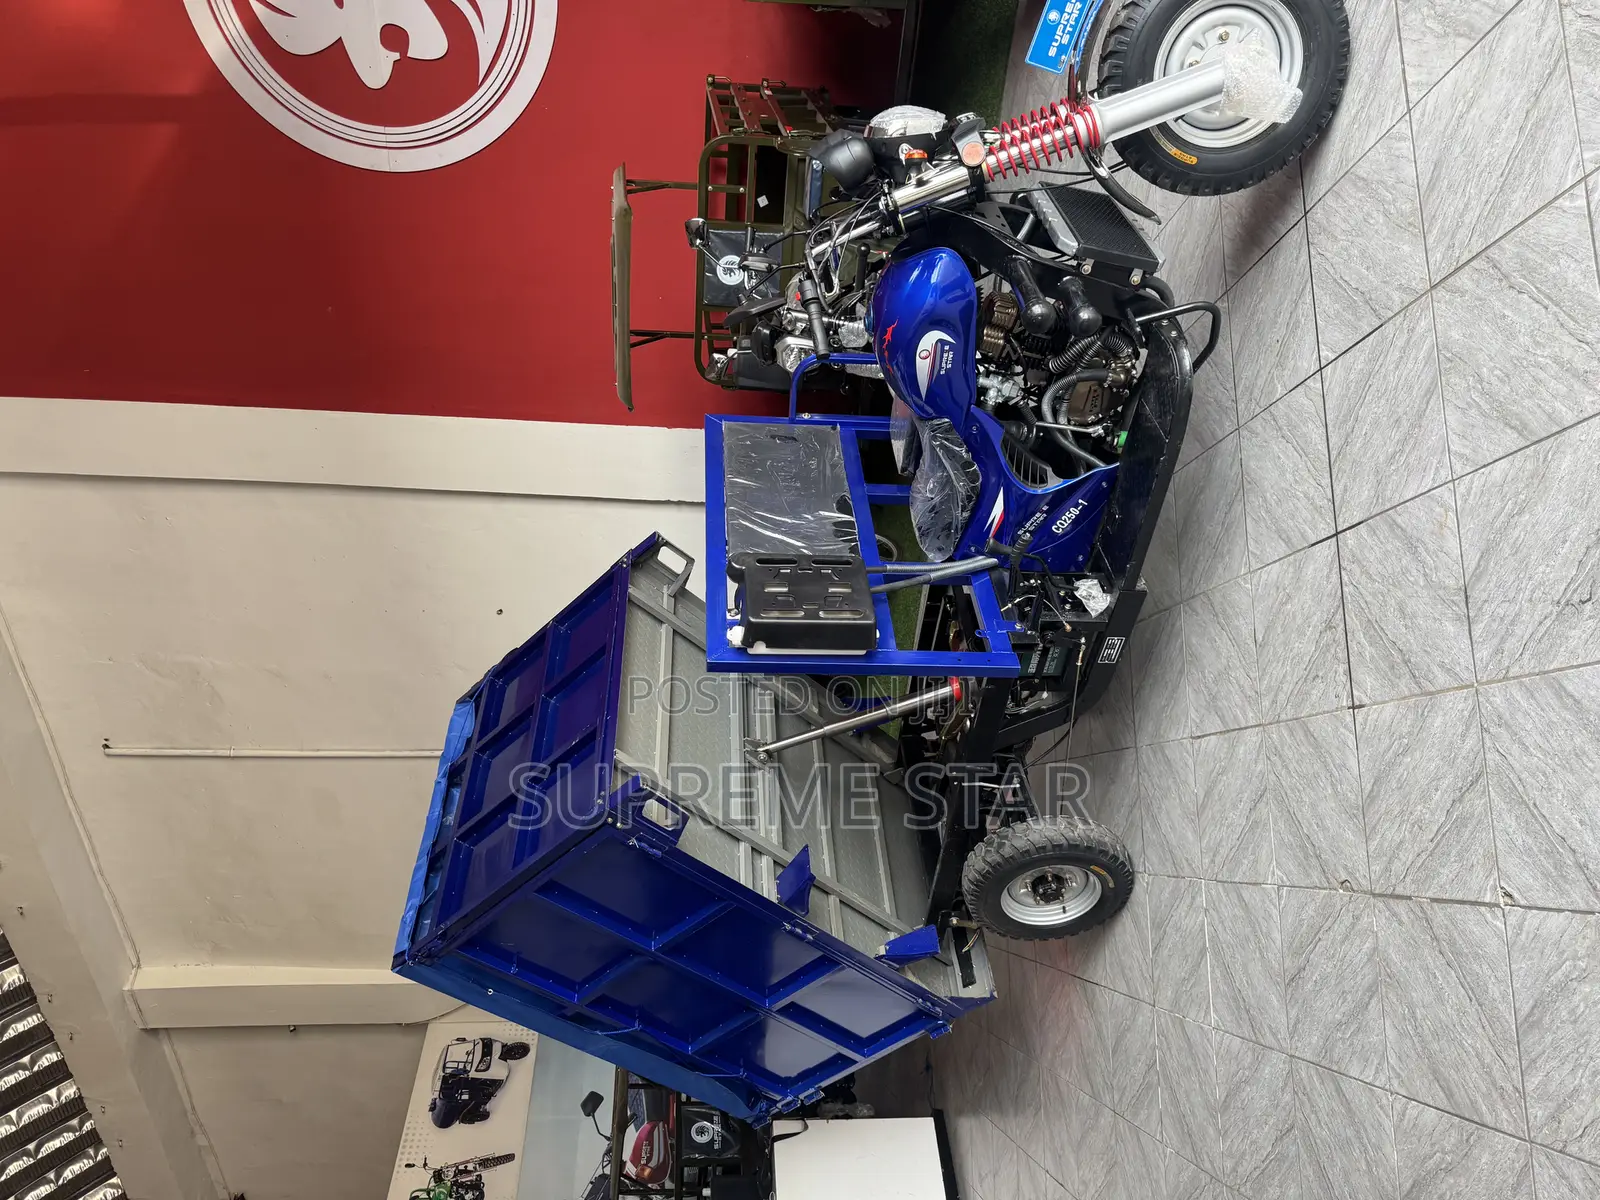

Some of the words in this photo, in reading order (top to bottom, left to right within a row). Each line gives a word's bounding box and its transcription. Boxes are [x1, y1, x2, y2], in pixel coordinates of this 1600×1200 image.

[1048, 0, 1077, 57] SUPRE
[1061, 2, 1083, 45] STAR
[1051, 498, 1088, 533] CQ250-1
